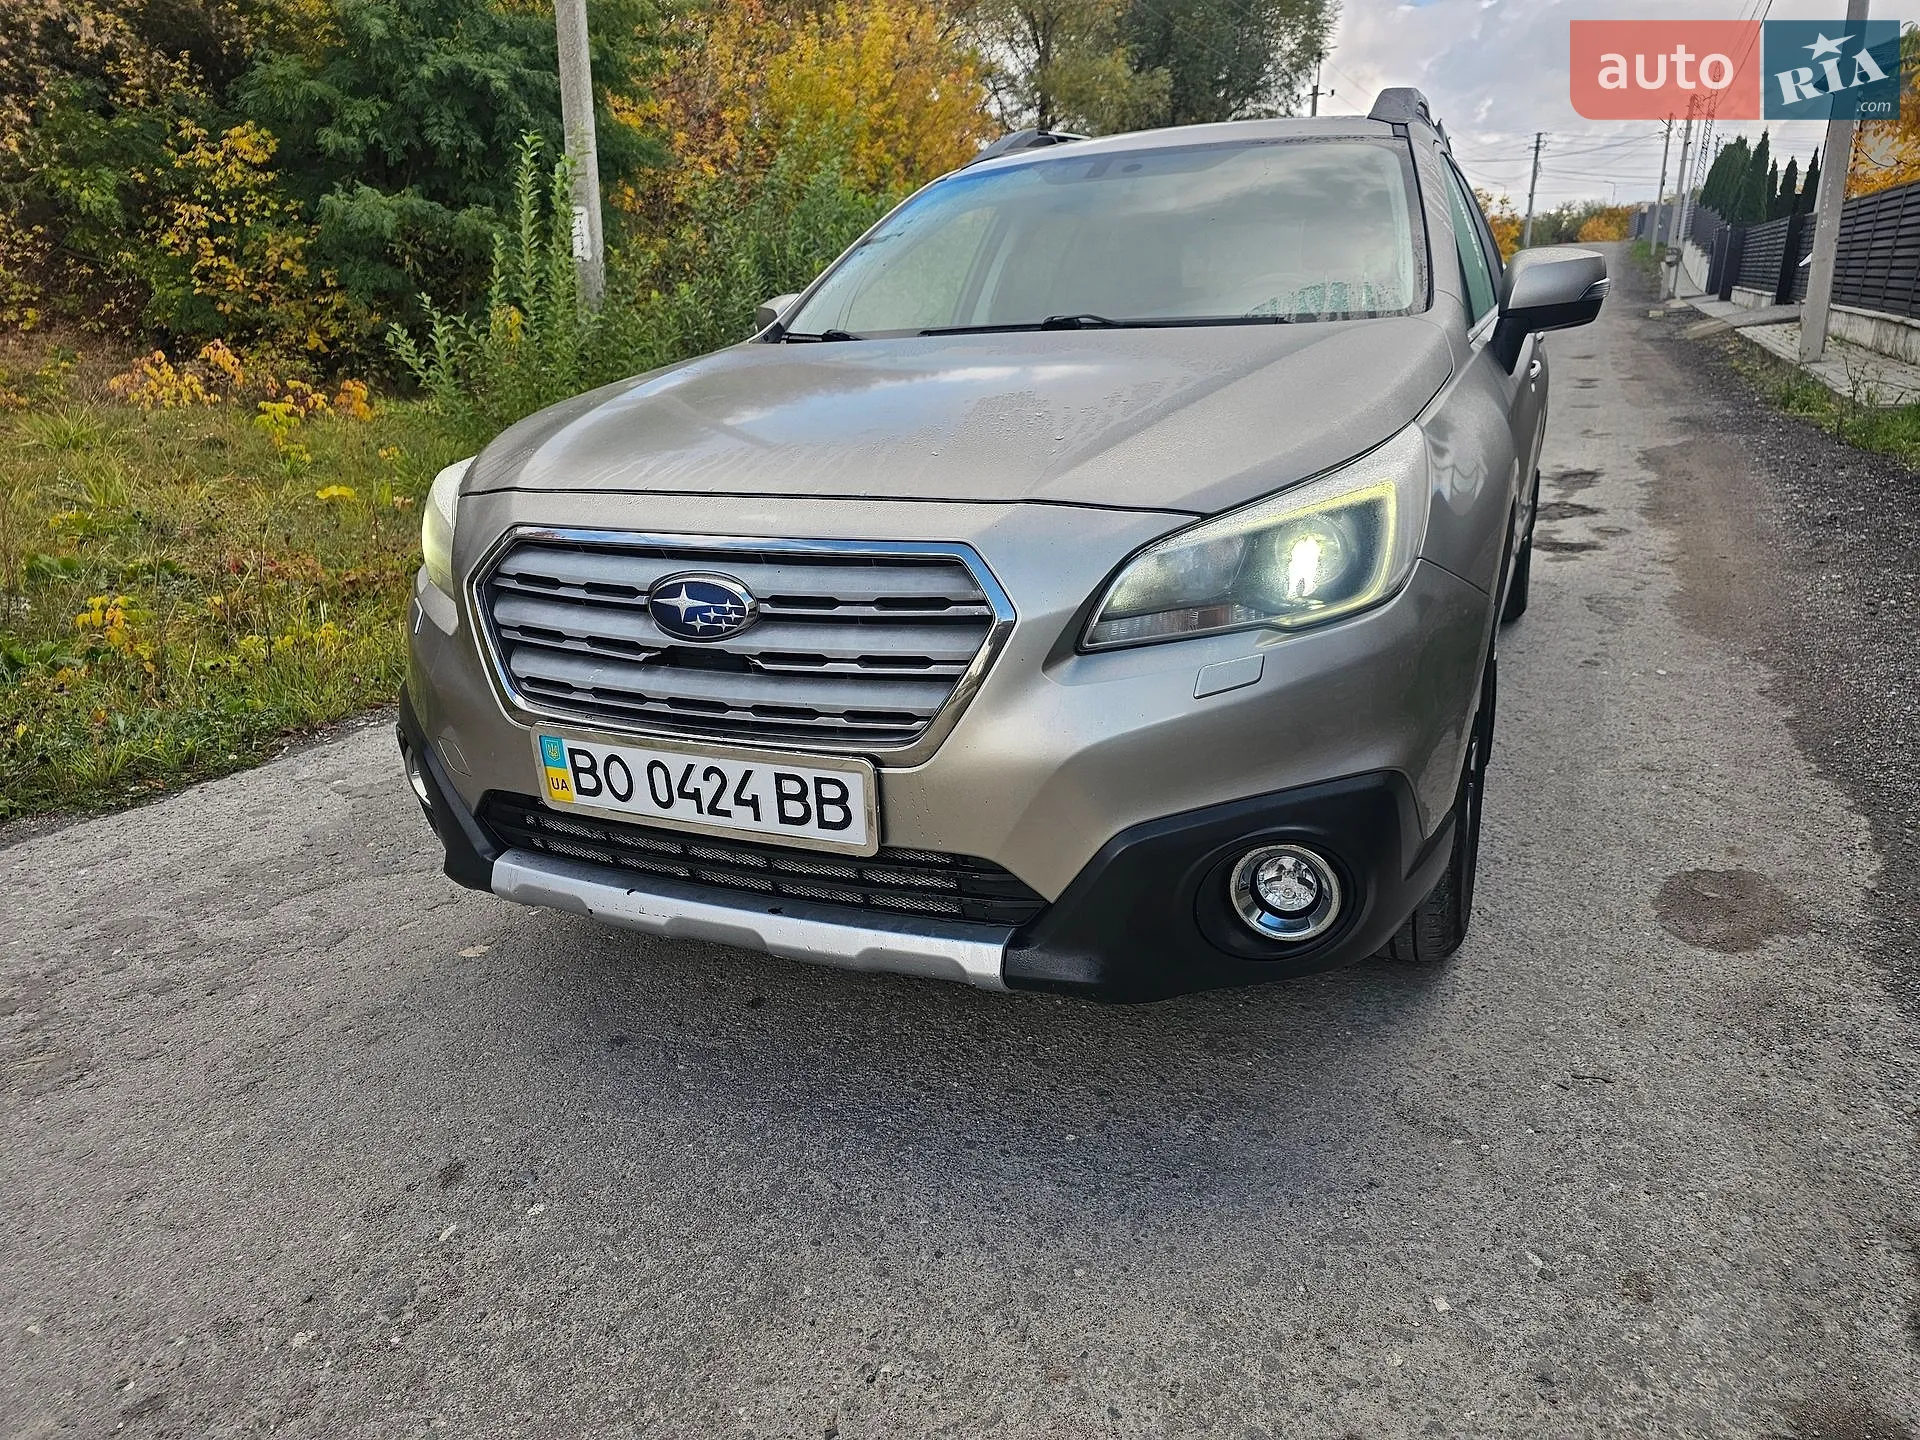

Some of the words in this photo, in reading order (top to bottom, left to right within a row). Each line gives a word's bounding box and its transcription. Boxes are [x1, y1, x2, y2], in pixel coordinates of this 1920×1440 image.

[551, 777, 570, 792] UA
[567, 747, 634, 803] BO
[647, 759, 762, 822] 0424
[774, 772, 853, 831] BB
